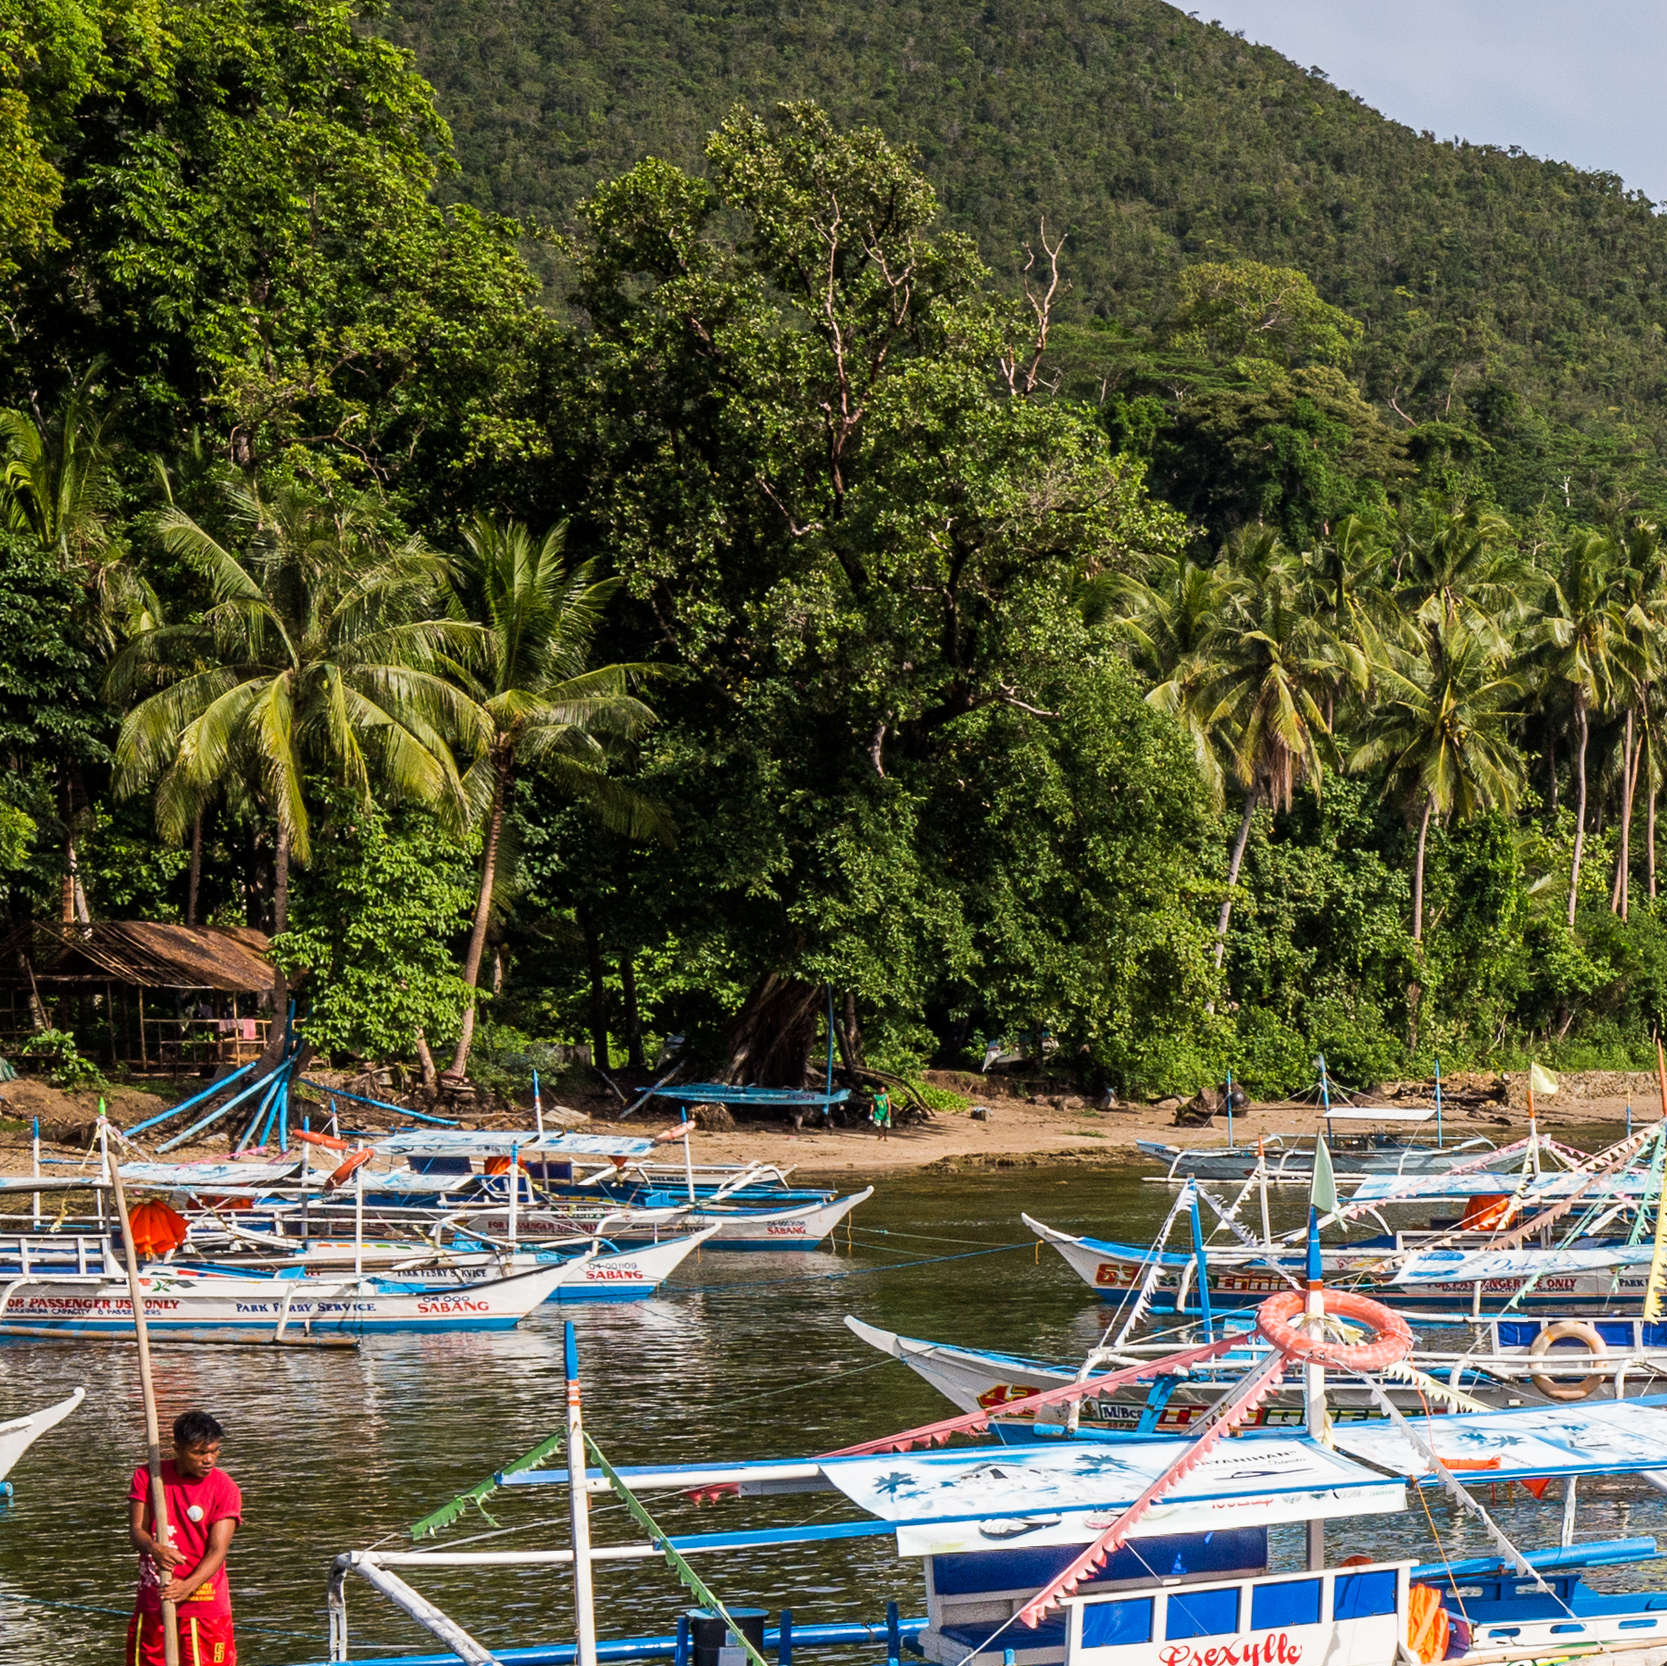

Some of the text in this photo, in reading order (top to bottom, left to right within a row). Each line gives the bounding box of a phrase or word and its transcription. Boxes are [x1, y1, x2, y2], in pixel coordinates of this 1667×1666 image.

[586, 1270, 643, 1280] SABANG
[1546, 1278, 1577, 1289] ONLY
[1619, 1279, 1644, 1288] PARK
[7, 1298, 180, 1310] OR PASSENGER US ONLY
[236, 1302, 376, 1313] PARK FRRY SERVICE
[417, 1301, 489, 1314] SABANG
